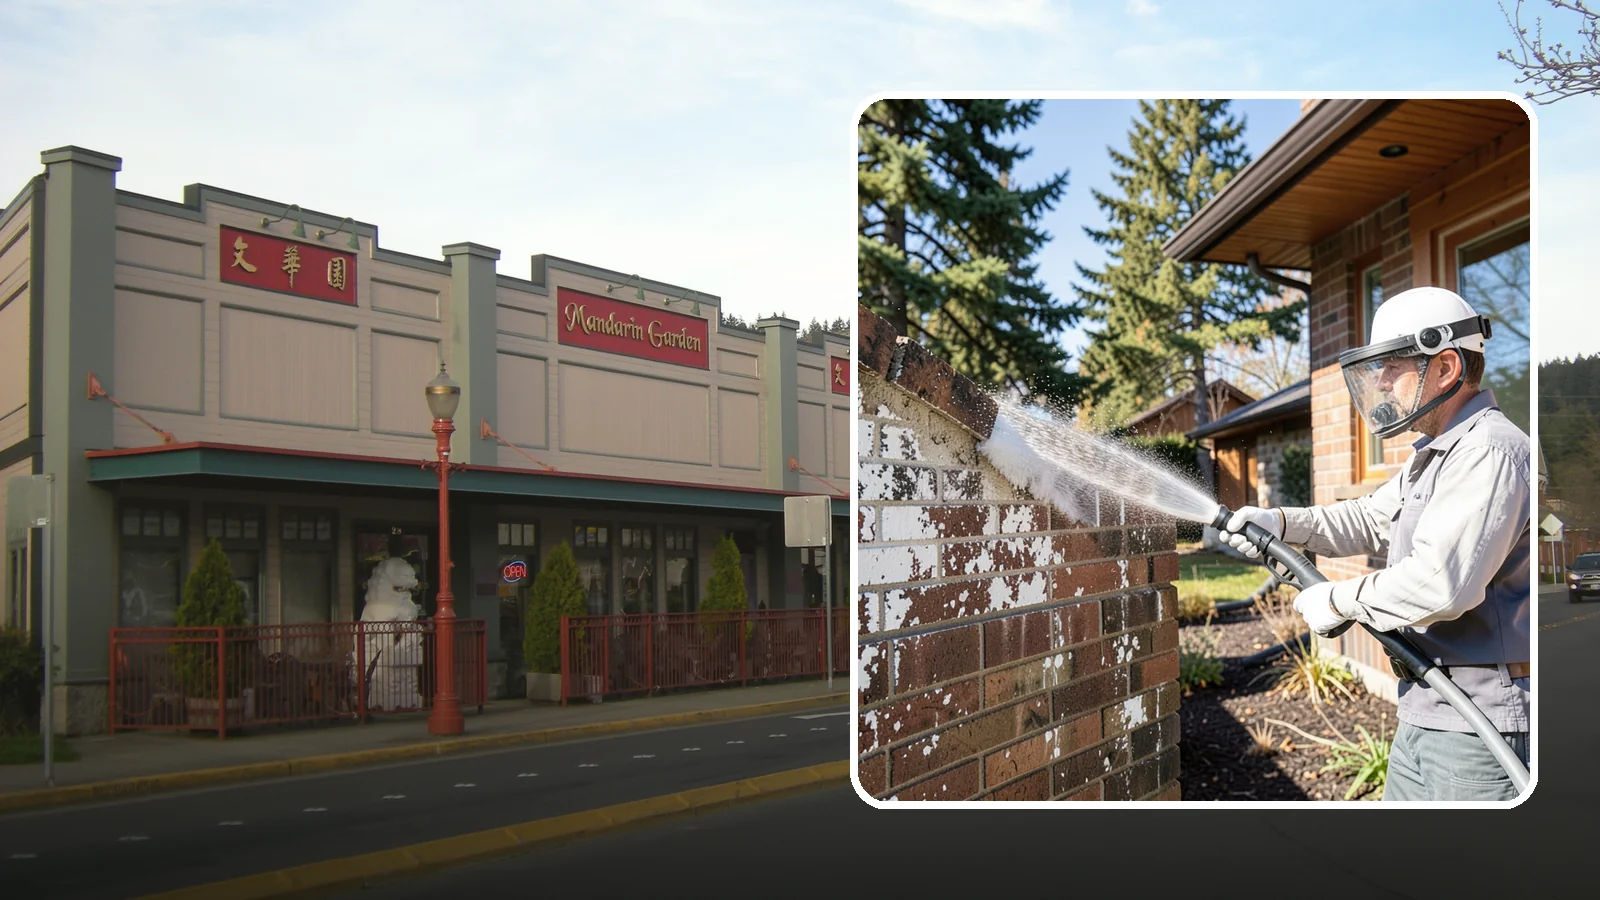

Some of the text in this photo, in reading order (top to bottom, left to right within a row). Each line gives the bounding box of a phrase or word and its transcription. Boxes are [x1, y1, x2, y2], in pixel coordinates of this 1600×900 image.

[231, 236, 346, 290] 文華園
[564, 302, 701, 352] Mandarin Garden
[503, 565, 527, 578] OPEN
